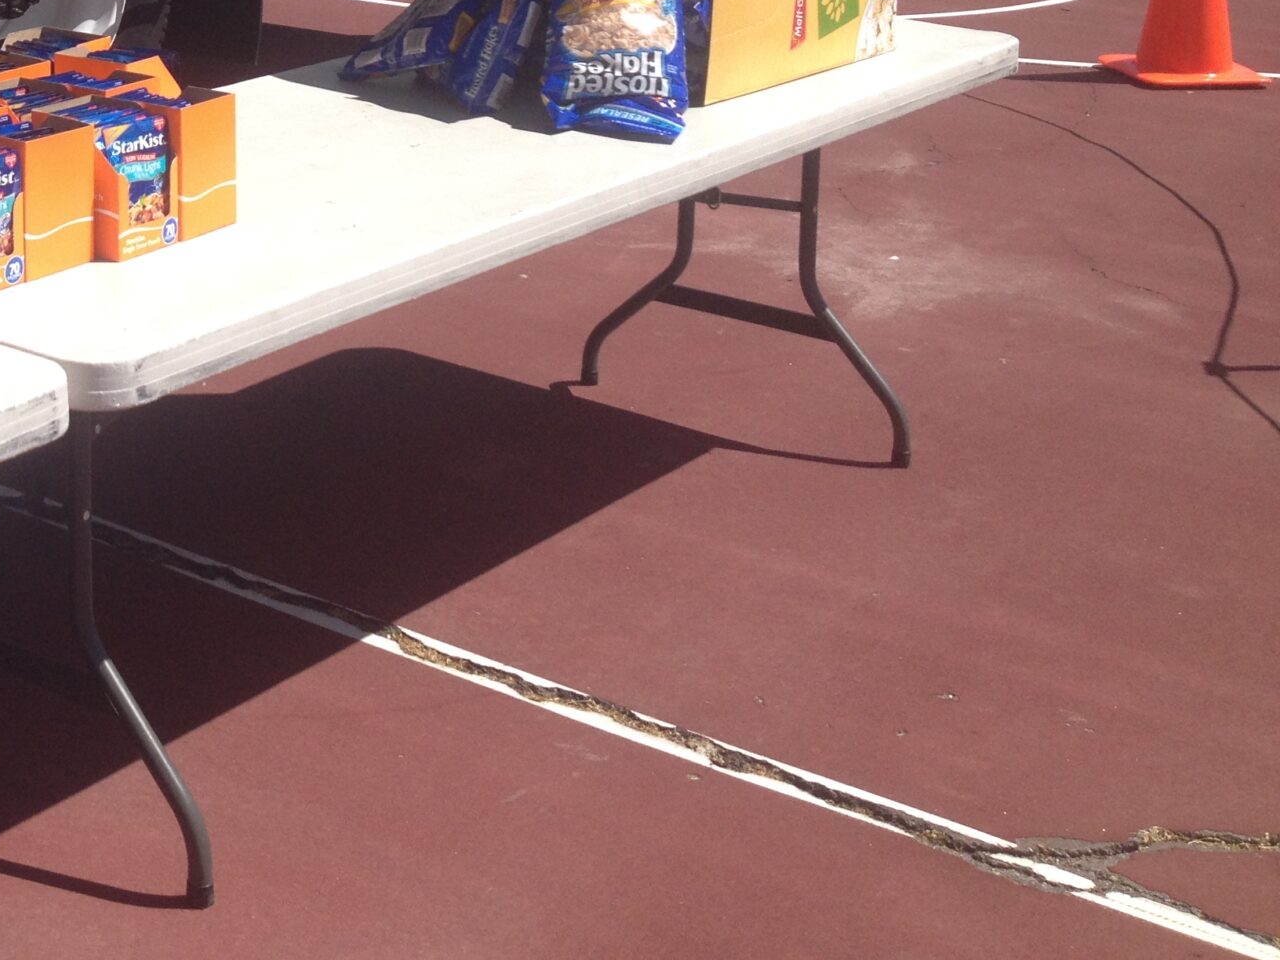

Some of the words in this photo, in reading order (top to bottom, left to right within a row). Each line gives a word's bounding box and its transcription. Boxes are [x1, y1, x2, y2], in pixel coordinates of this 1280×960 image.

[572, 50, 663, 77] Flakes
[111, 132, 165, 156] StarKist
[8, 261, 21, 276] 70
